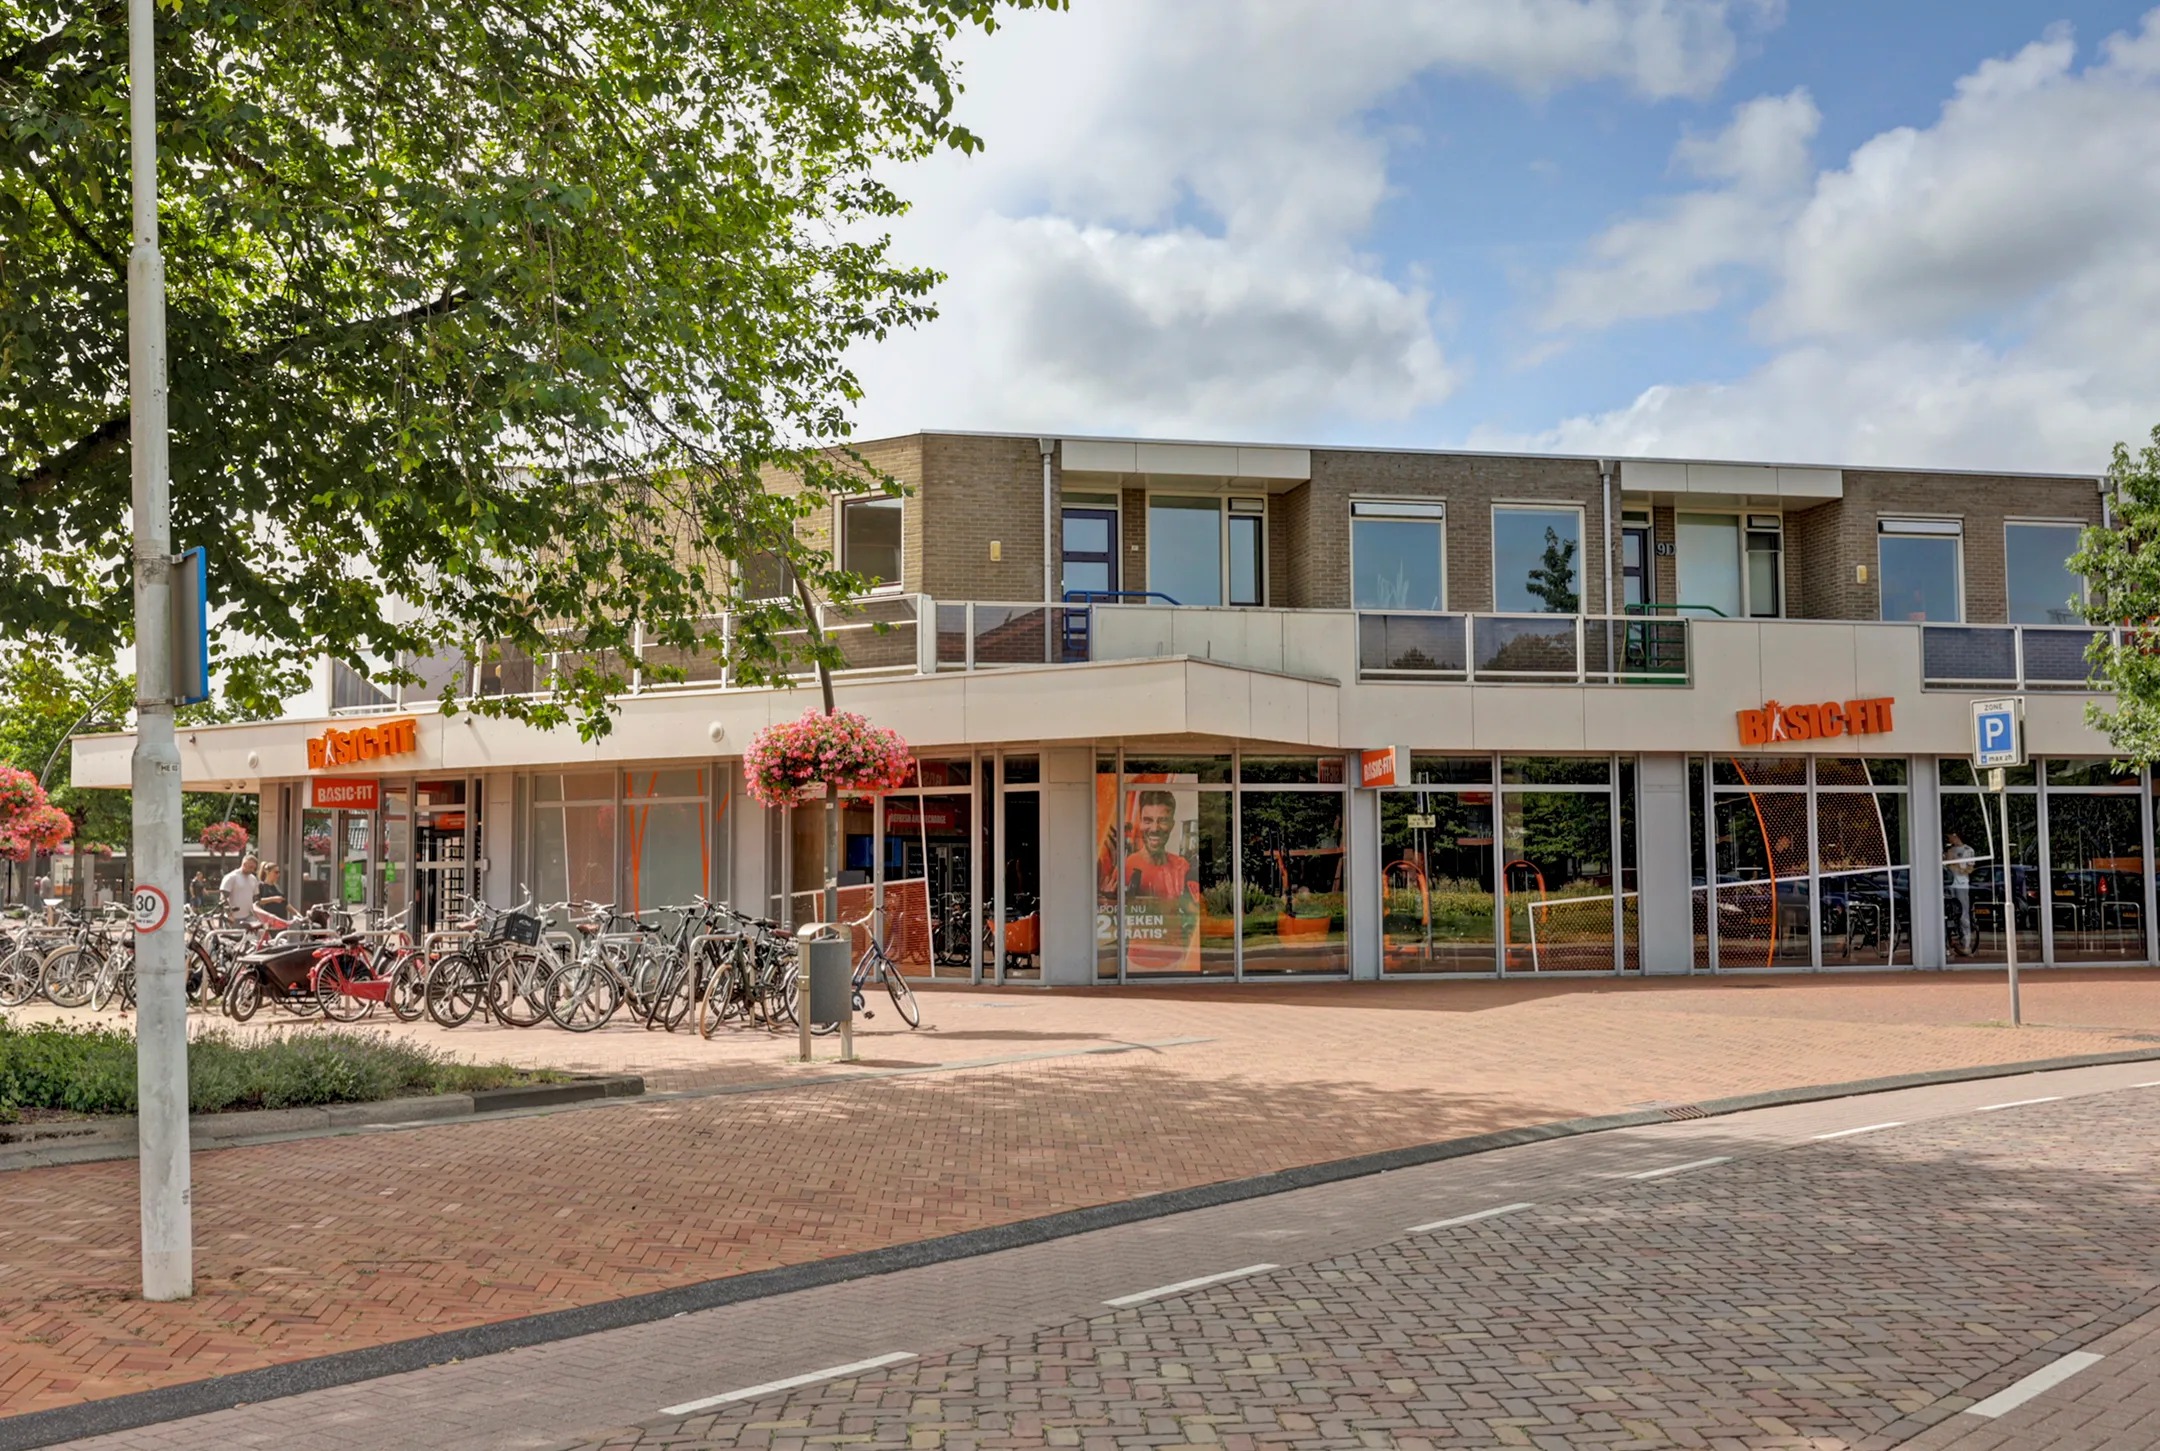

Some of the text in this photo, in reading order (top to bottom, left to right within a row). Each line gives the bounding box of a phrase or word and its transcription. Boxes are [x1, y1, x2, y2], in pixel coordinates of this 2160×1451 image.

[1656, 543, 1676, 556] 9D
[1984, 703, 2003, 711] ZONE
[1736, 697, 1895, 745] BASIC-FIT
[1985, 717, 2004, 749] P
[307, 719, 417, 770] BASIC-FIT
[317, 785, 374, 803] BASIC-FIT
[136, 895, 156, 912] 30
[1130, 905, 1147, 913] NU
[1097, 915, 1112, 938] 2
